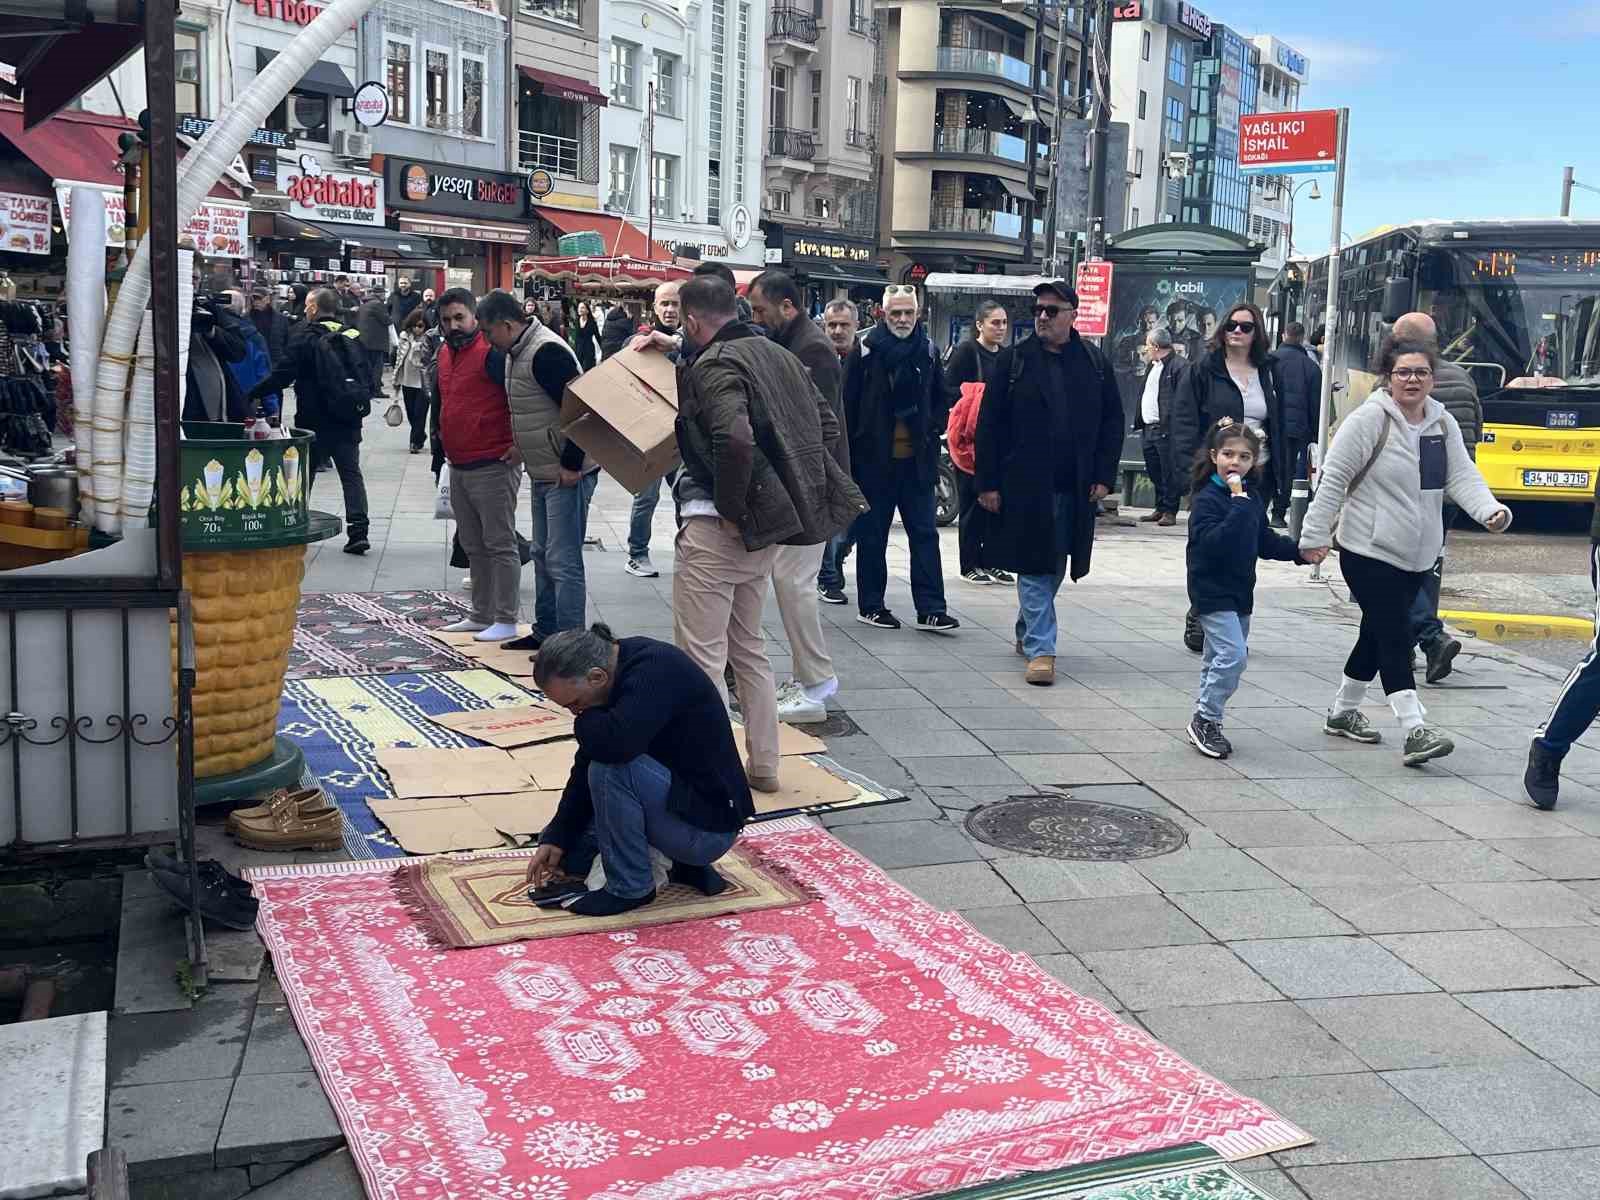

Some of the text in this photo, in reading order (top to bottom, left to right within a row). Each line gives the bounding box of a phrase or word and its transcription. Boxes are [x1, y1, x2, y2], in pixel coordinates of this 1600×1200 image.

[1244, 121, 1305, 136] YAĞLIKÇI
[1244, 136, 1289, 152] İSMAİL
[432, 174, 473, 200] yesen
[477, 179, 519, 204] BURGER
[1530, 472, 1542, 482] 34
[1563, 474, 1586, 484] 3715
